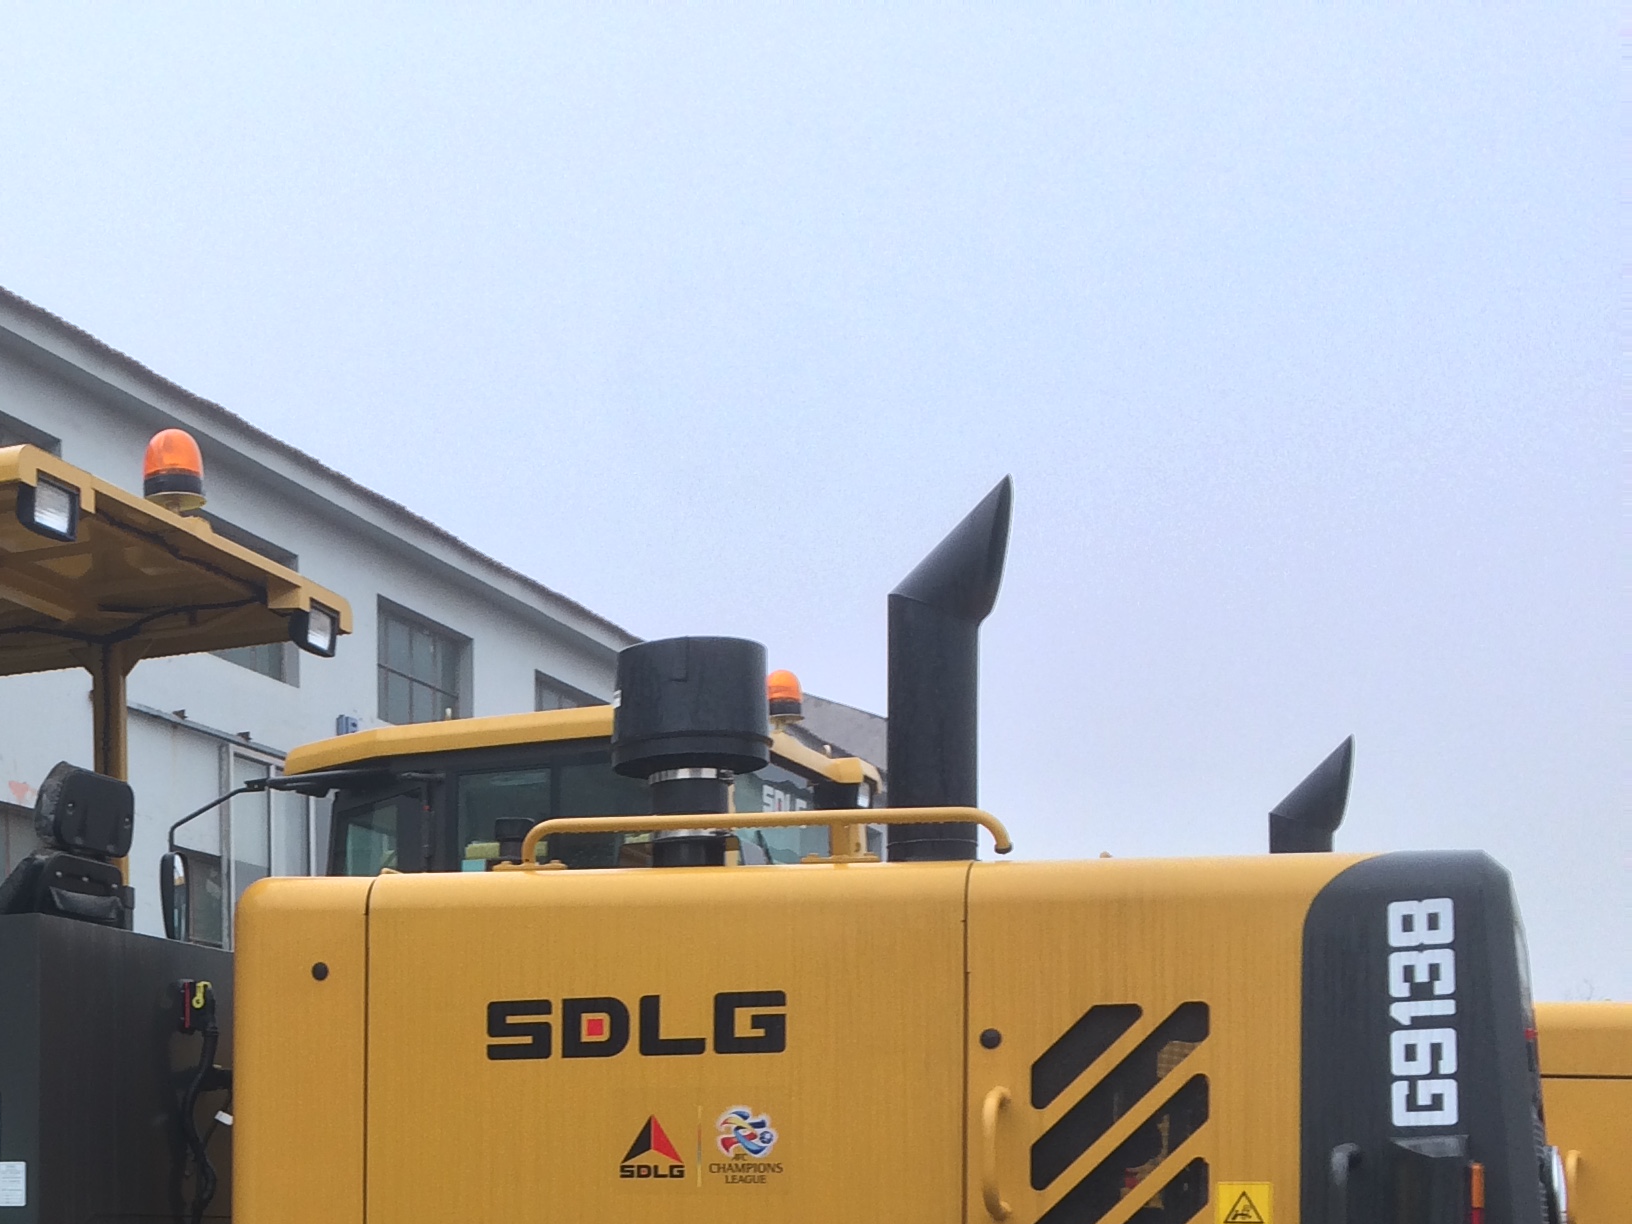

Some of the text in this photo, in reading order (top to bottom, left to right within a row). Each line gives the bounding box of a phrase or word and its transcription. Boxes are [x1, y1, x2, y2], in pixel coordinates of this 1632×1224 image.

[1387, 897, 1460, 1127] G9138
[487, 990, 786, 1061] SDLG
[619, 1164, 686, 1179] SDLG
[708, 1162, 784, 1175] CHAMPIONS
[724, 1174, 767, 1185] LEAGUE
